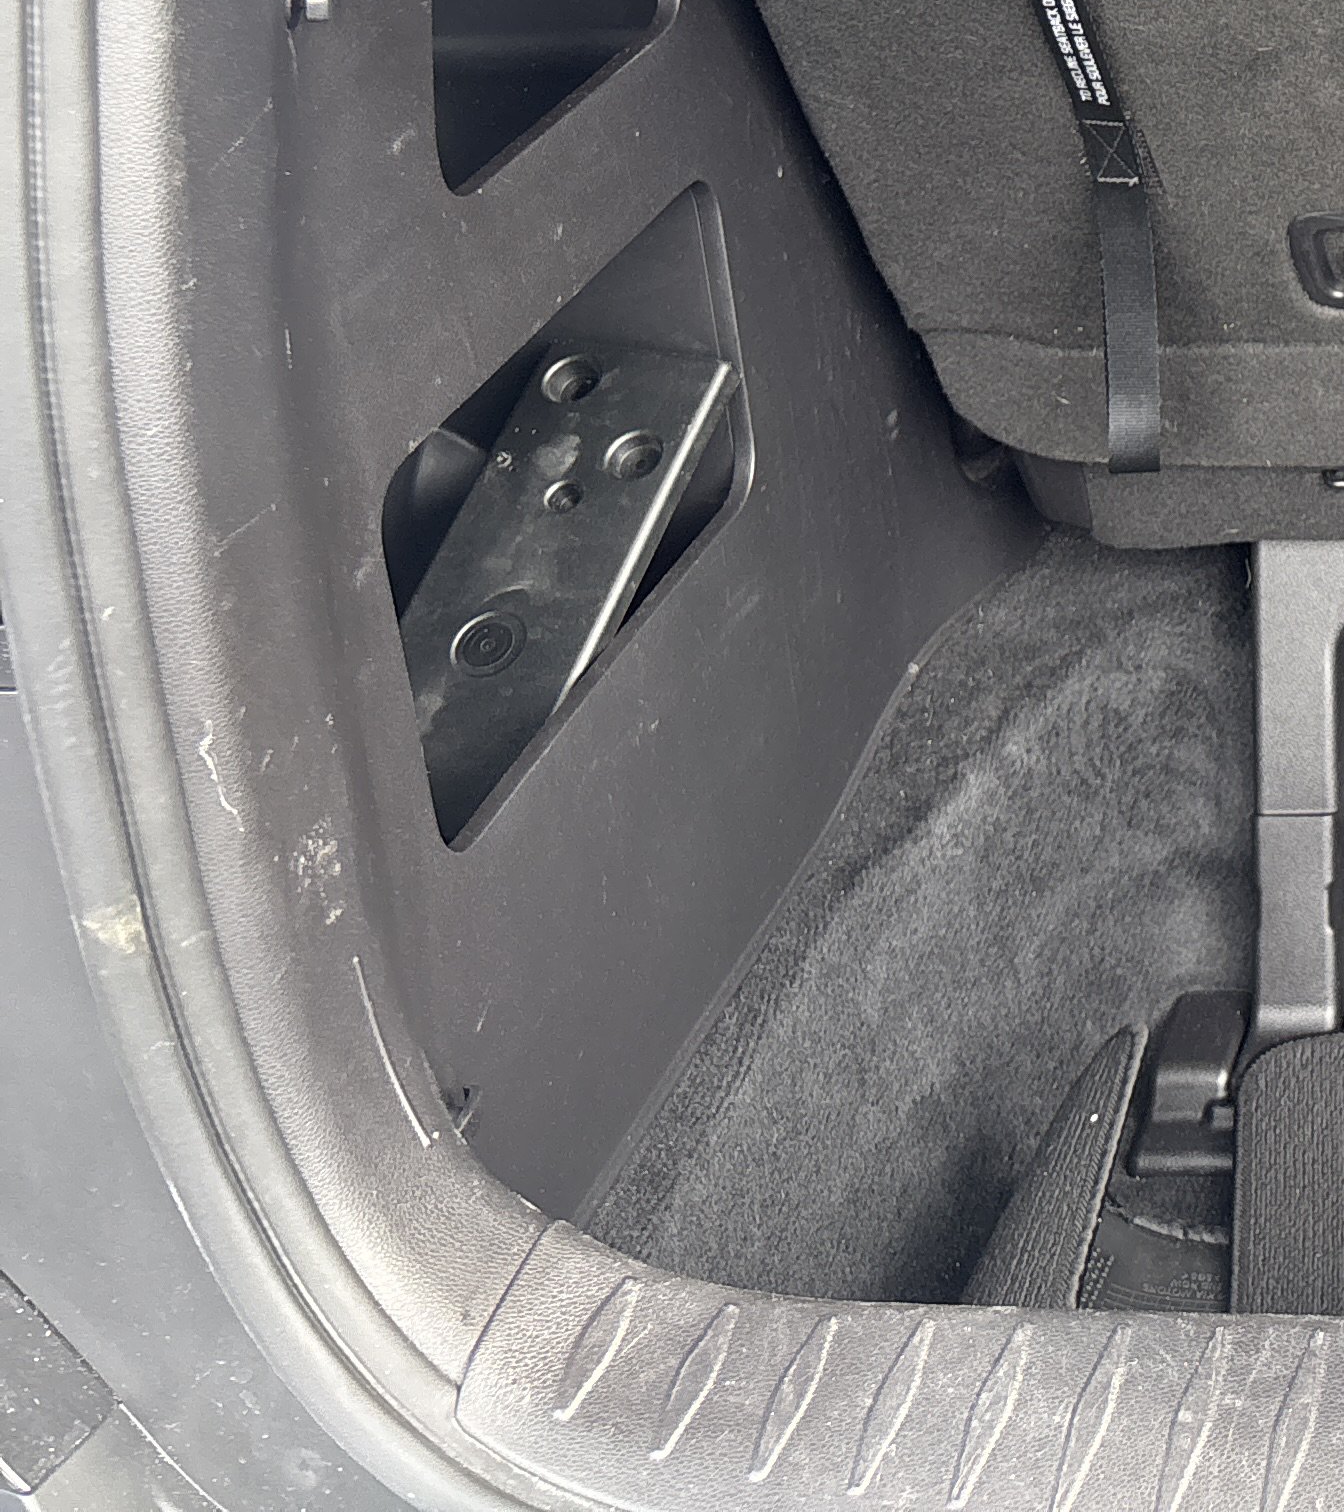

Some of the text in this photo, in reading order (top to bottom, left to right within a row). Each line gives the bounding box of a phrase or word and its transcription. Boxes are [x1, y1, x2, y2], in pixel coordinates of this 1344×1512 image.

[1045, 7, 1074, 55] SEATBACK
[1068, 22, 1084, 36] LE
[1063, 54, 1089, 90] RECLINE
[1073, 35, 1102, 81] SOULEVER
[1079, 89, 1093, 102] TO
[1091, 80, 1111, 106] POUR
